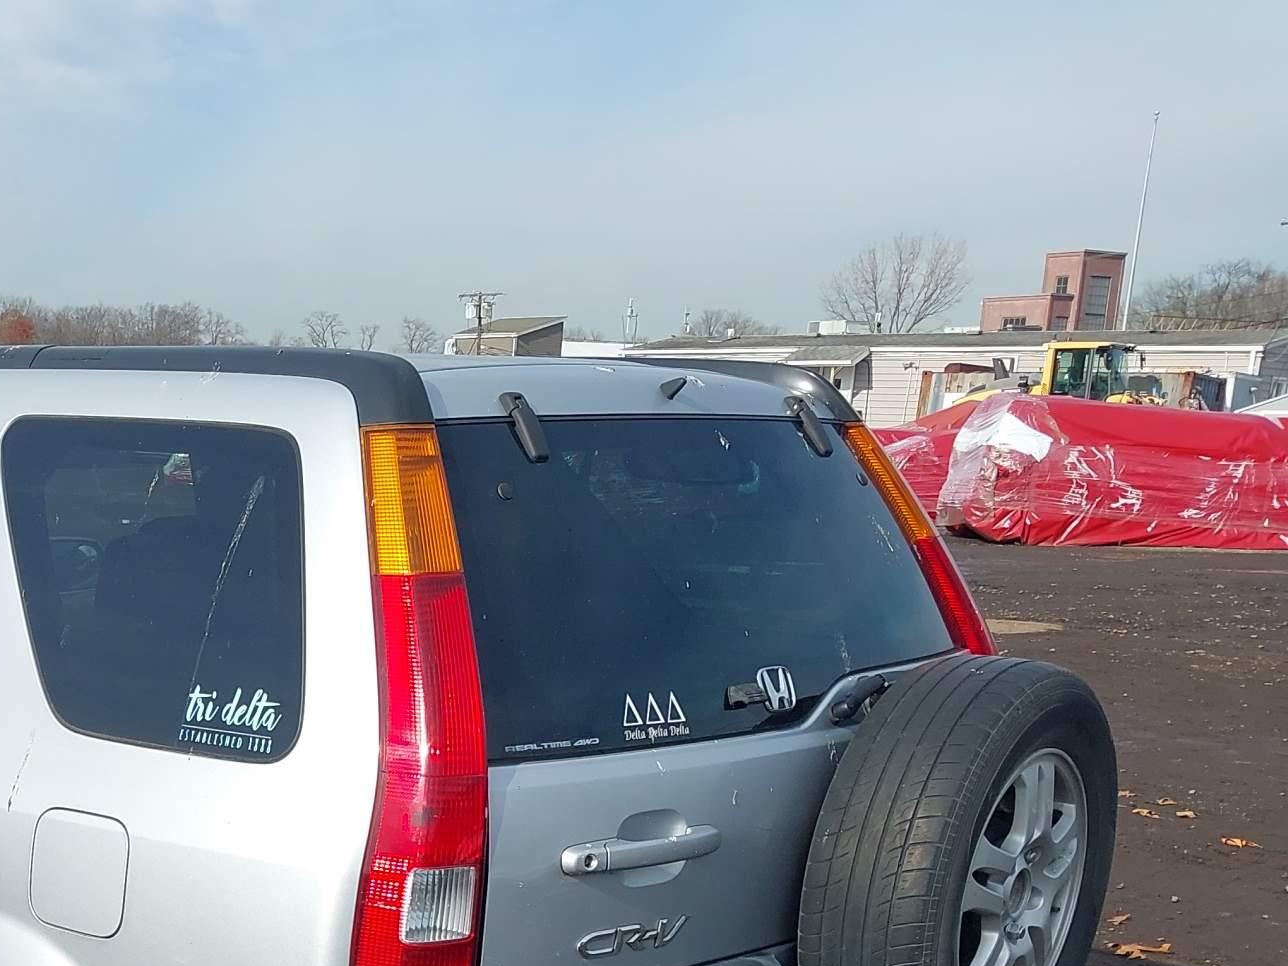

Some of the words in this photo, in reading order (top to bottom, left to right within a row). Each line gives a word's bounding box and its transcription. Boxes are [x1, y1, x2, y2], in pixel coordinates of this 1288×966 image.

[185, 684, 219, 722] tri
[221, 687, 282, 732] delta
[179, 728, 243, 749] ESTABLISHED
[247, 737, 273, 754] 1888
[504, 740, 571, 753] REALTIME
[573, 737, 600, 747] 4WD
[624, 729, 646, 741] Delta
[648, 727, 668, 739] Delta
[669, 724, 690, 737] Delta
[576, 915, 690, 959] CR-V
